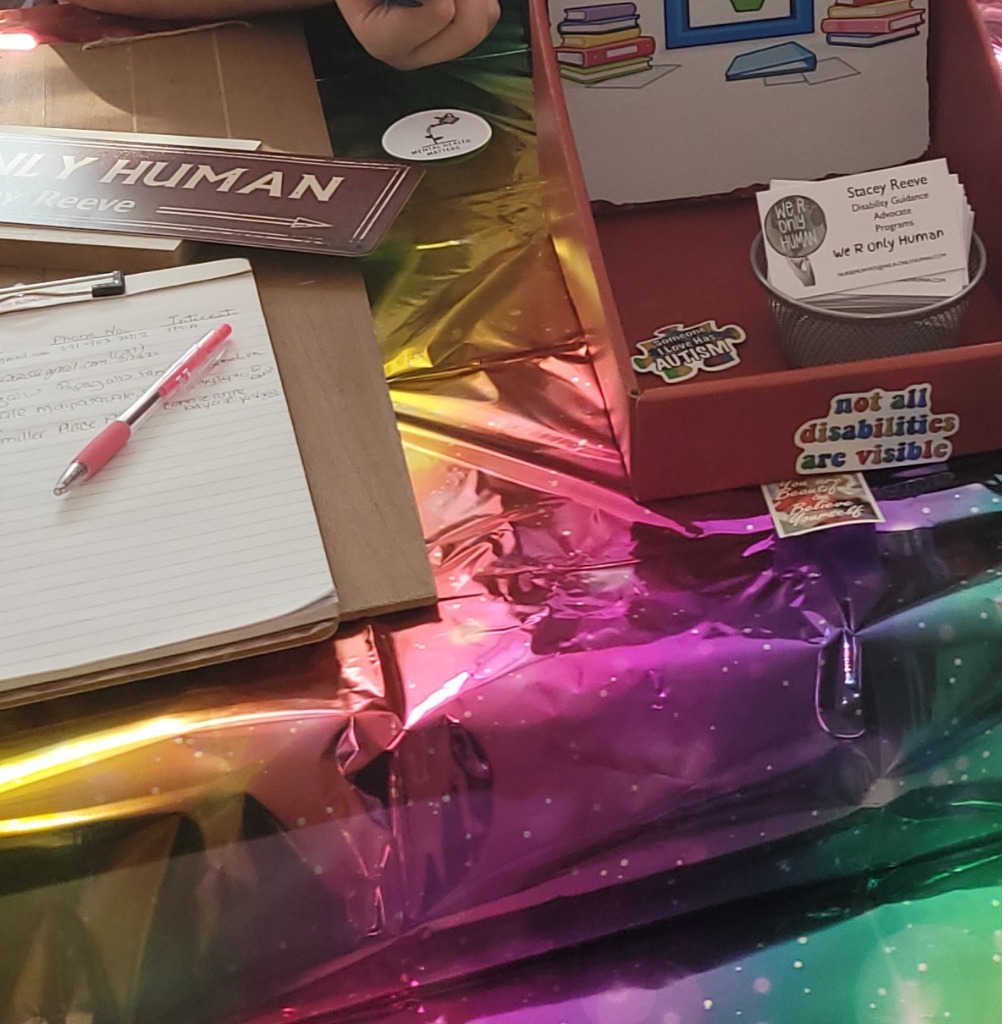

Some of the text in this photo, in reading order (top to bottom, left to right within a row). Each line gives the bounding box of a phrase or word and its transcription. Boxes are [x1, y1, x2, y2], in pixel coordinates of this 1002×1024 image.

[410, 139, 471, 156] MENTAL HEALTH
[427, 146, 461, 156] MATTERS
[98, 158, 345, 203] HUMAN
[847, 176, 928, 199] Stacey Reeve
[31, 189, 136, 213] Reeve
[774, 198, 806, 219] We R
[851, 193, 930, 213] Disability Guidance
[873, 208, 912, 221] Advocate
[875, 220, 914, 233] Programs
[780, 228, 818, 252] HUMAN
[832, 247, 851, 258] We
[853, 243, 864, 254] R
[898, 229, 945, 246] Human
[652, 328, 705, 347] Someone
[664, 341, 693, 354] Love
[692, 334, 717, 345] Has
[656, 339, 733, 371] AUTISM
[834, 387, 928, 414] not all
[799, 414, 956, 444] disabilities
[800, 439, 949, 470] are visible
